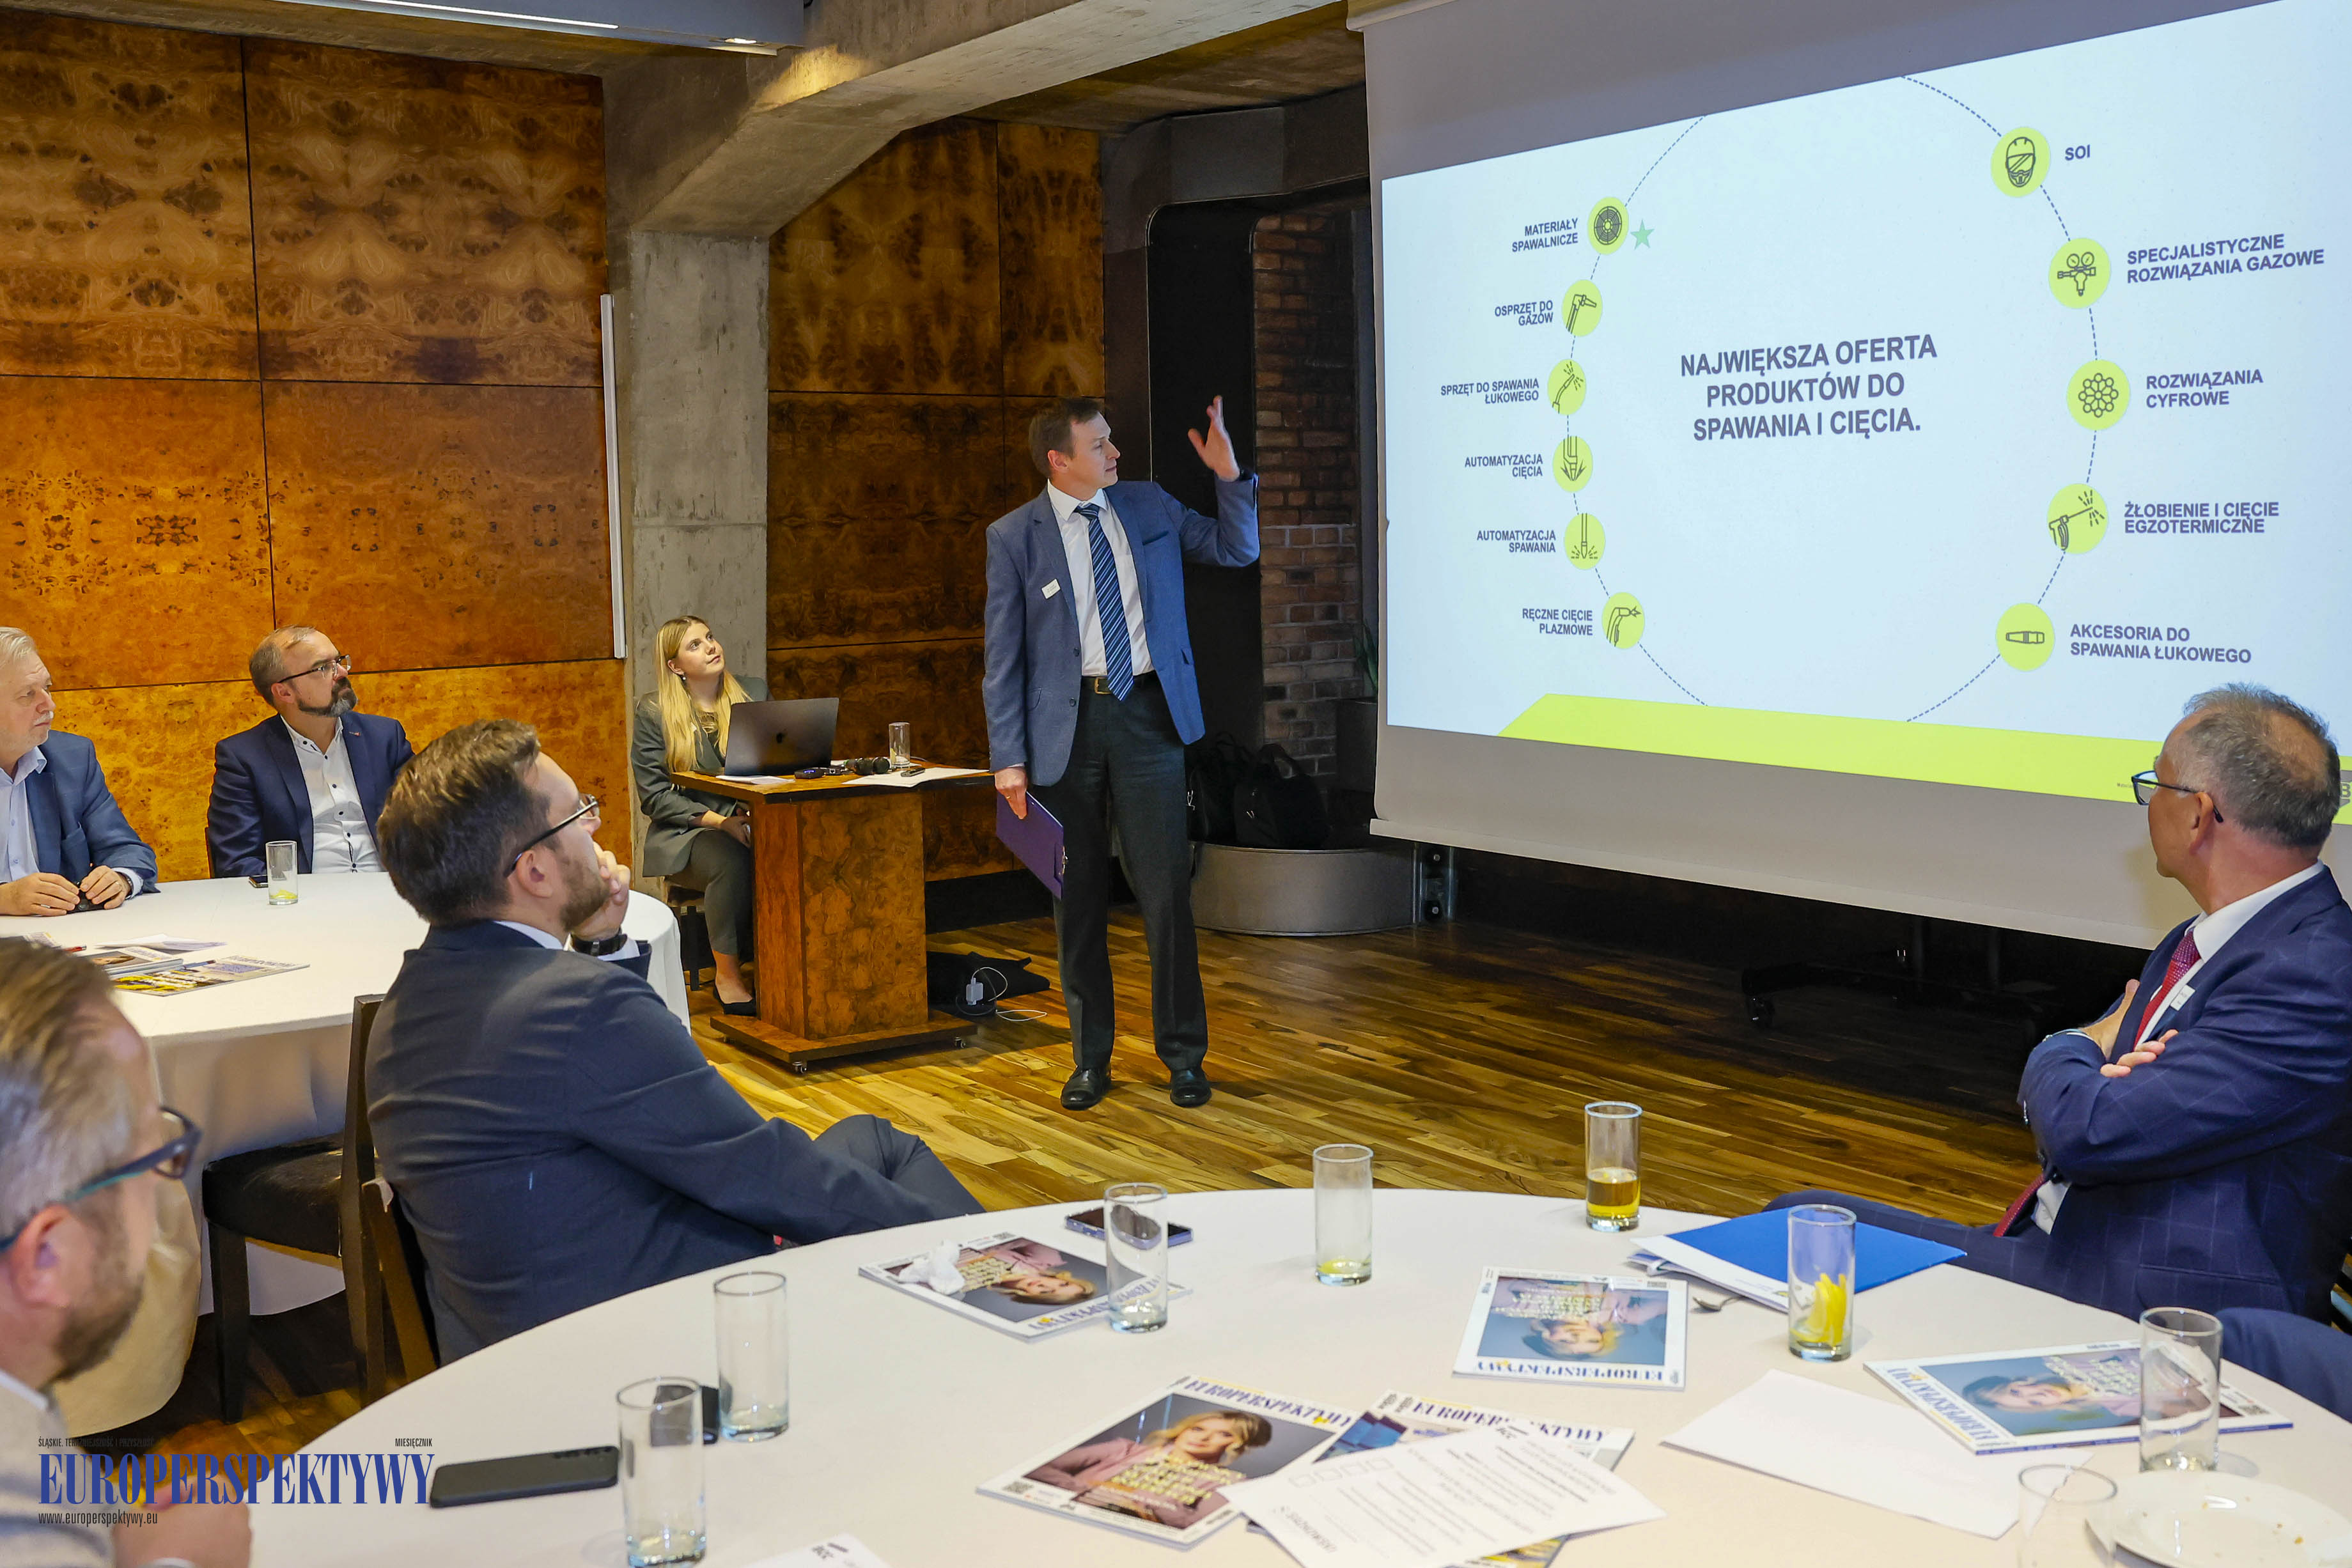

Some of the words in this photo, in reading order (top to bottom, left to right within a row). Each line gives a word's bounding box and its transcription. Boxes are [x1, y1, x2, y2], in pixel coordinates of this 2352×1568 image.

[2064, 144, 2091, 161] SOI
[1525, 218, 1578, 237] MATERIAŁY
[1512, 233, 1578, 252] SPAWALNICZE
[2127, 233, 2285, 265] SPECJALISTYCZNE
[2127, 260, 2242, 283] ROZWIĄZANIA
[2247, 249, 2325, 271] GAZOWE
[1495, 302, 1538, 318] OSPRZĘT
[1539, 300, 1554, 311] DO
[1518, 310, 1554, 326] GAZÓW
[1681, 343, 1830, 376] NAJWIĘKSZA
[1835, 334, 1938, 364] OFERTA
[1440, 382, 1474, 397] SPRZĘT
[1476, 381, 1490, 392] DO
[1492, 378, 1539, 391] SPAWANIA
[2146, 369, 2264, 390] ROZWIĄZANIA
[1485, 391, 1539, 404] ŁUKOWEGO
[1707, 371, 1860, 407] PRODUKTÓW
[1867, 372, 1904, 398] DO
[2146, 391, 2230, 408] CYFROWE
[1694, 413, 1811, 441] SPAWANIA
[1817, 412, 1822, 435] I
[1830, 407, 1920, 439] CIĘCIA.
[1465, 454, 1543, 467] AUTOMATYZACJA
[1512, 467, 1543, 479] CIĘCIA
[2124, 501, 2209, 518] ŻŁOBIENIE
[2214, 504, 2218, 517] I
[2223, 502, 2280, 521] CIĘCIE
[2124, 518, 2265, 533] EGZOTERMICZNE
[1477, 530, 1556, 541] AUTOMATYZACJA
[1509, 542, 1556, 553] SPAWANIA
[1522, 609, 1559, 622] RĘCZNE
[1561, 609, 1593, 624] CIĘCIE
[1539, 624, 1593, 636] PLAZMOWE
[2070, 624, 2163, 640] AKCESORIA
[2167, 627, 2190, 641] DO
[2070, 642, 2151, 660] SPAWANIA
[2154, 646, 2252, 663] ŁUKOWEGO
